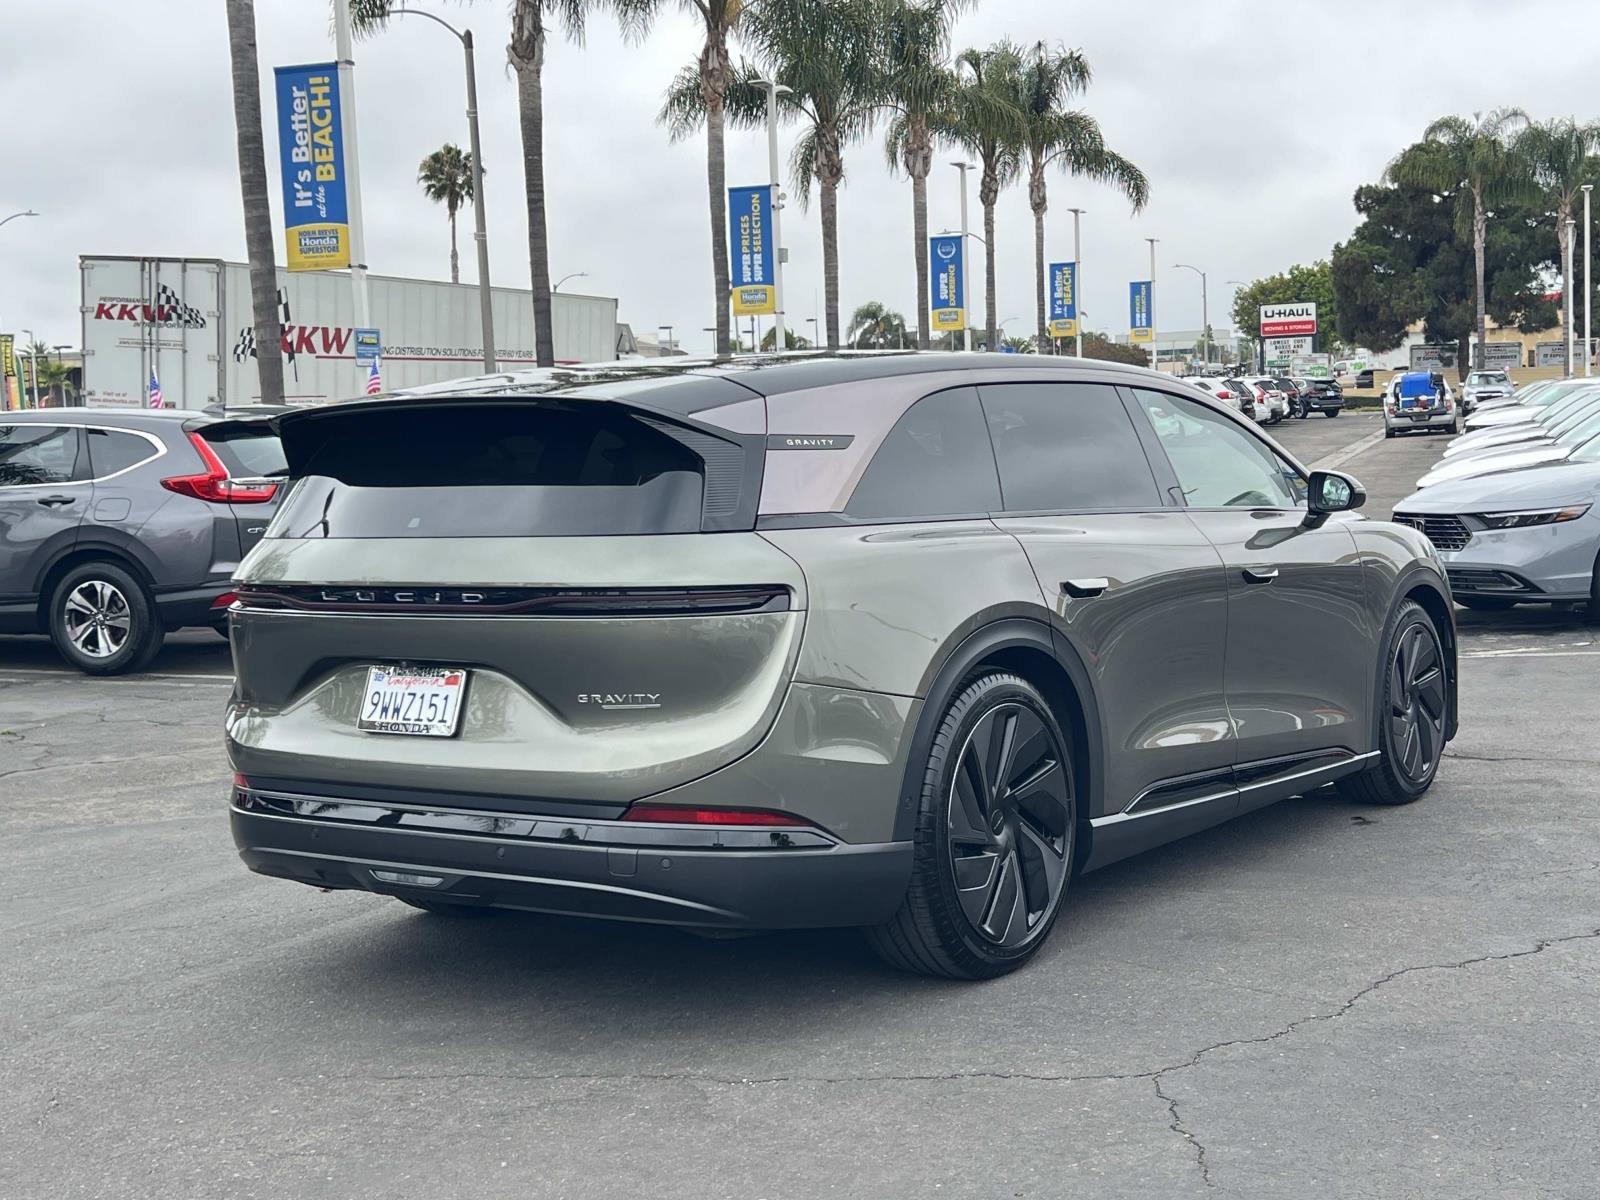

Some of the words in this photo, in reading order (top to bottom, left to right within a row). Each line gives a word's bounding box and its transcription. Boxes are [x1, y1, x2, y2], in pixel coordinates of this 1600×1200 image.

[291, 86, 307, 163] Better
[309, 77, 336, 182] BEACH!
[293, 169, 312, 207] It's
[751, 193, 762, 252] SELECTION
[301, 236, 337, 246] Honda
[740, 215, 750, 253] PRICES
[94, 303, 174, 321] KKW
[1264, 308, 1312, 318] U-HAUL
[394, 347, 441, 356] DISTRIBUTION
[442, 348, 477, 357] SOLUTIONS
[321, 592, 484, 602] LUCID
[367, 690, 450, 723] 9WWZ151
[578, 694, 661, 703] GRAVITY
[380, 722, 431, 733] HONDA
